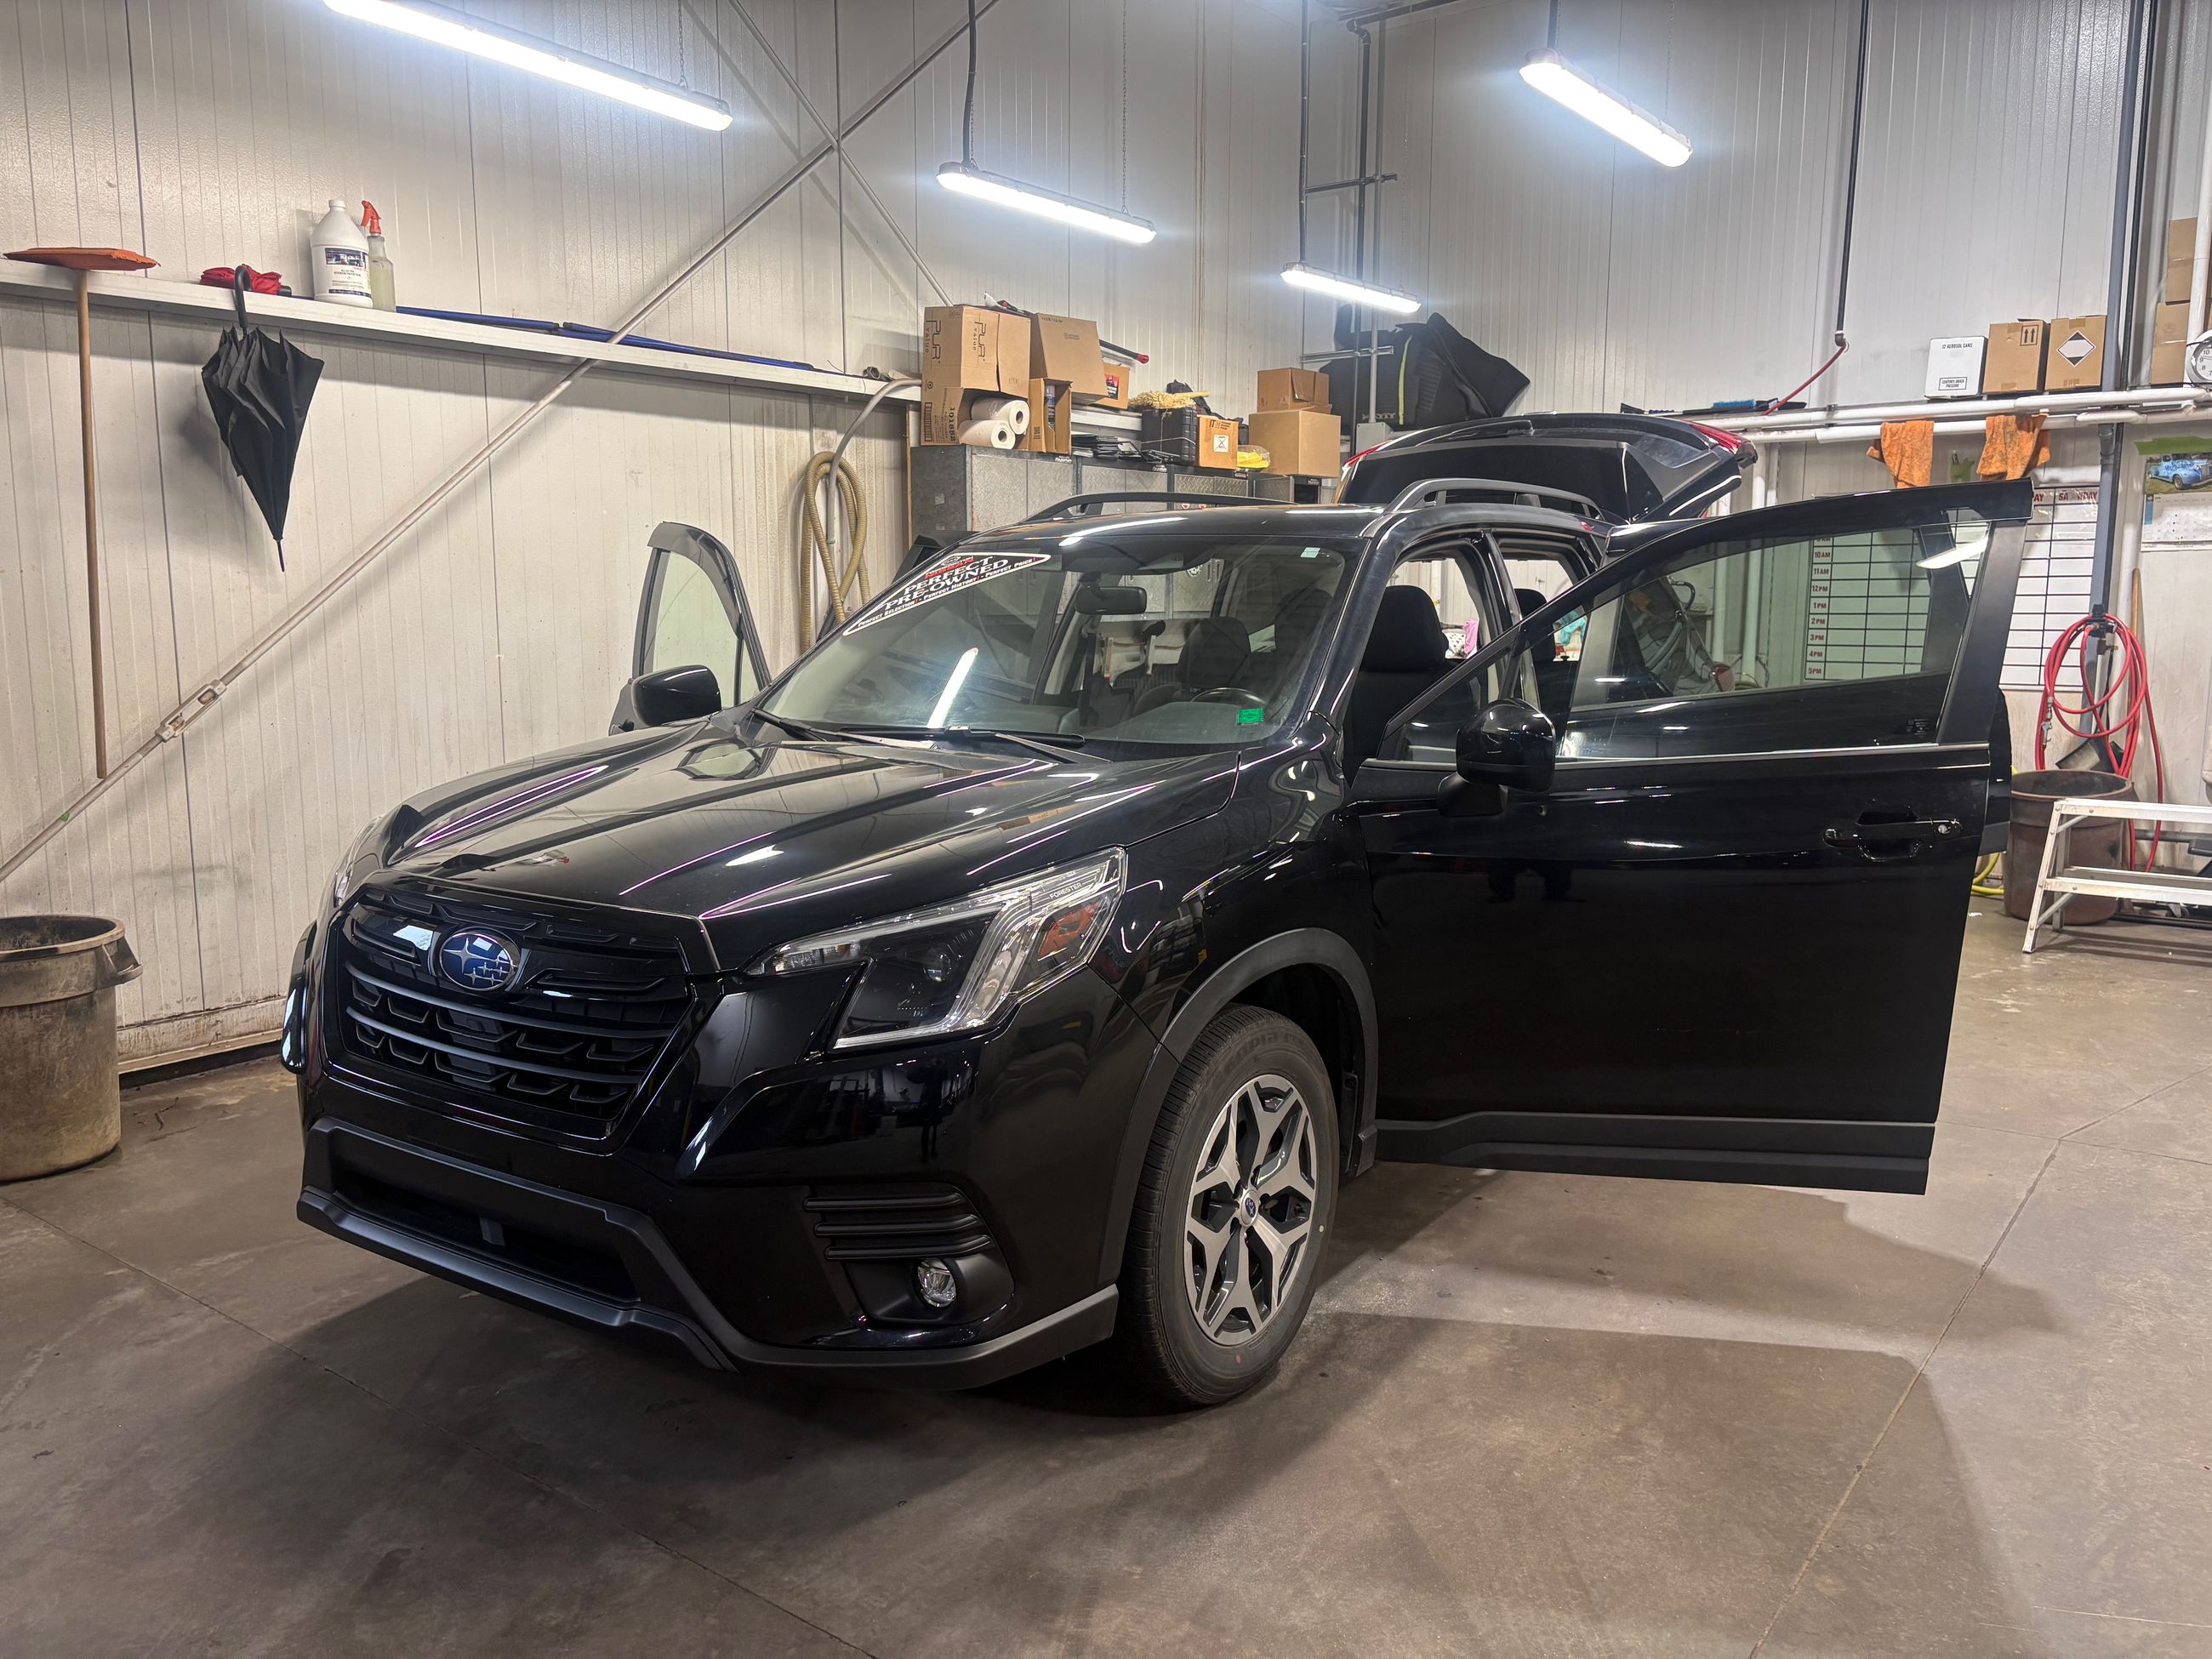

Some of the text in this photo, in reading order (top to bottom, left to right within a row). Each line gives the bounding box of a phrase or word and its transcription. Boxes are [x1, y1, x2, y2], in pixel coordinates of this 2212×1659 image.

[884, 559, 1009, 610] PRE-OWNED
[904, 556, 994, 596] PERFECT
[1049, 882, 1082, 899] FORESTER
